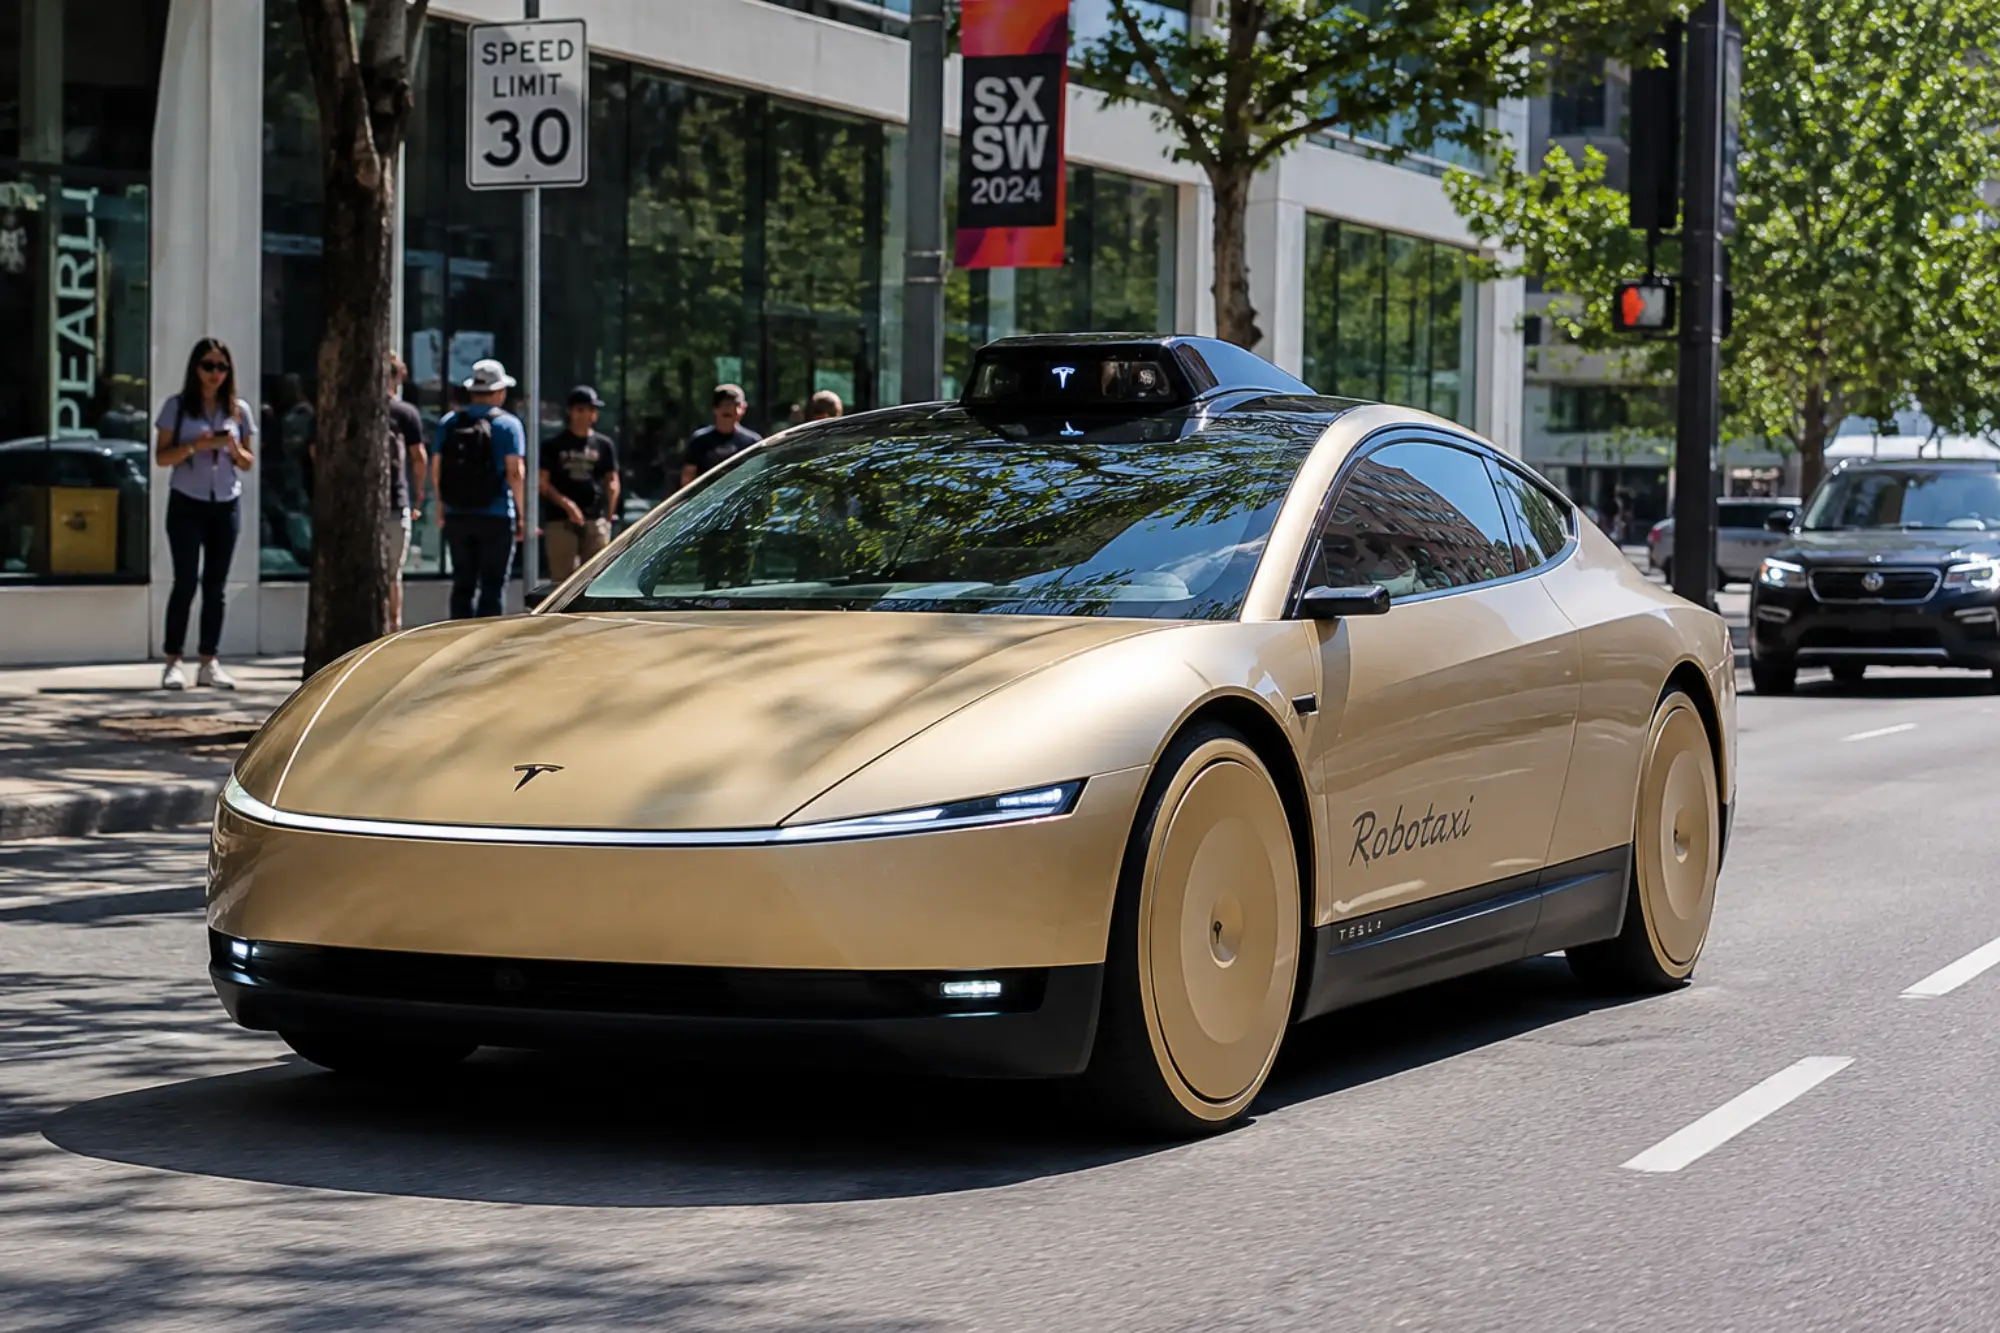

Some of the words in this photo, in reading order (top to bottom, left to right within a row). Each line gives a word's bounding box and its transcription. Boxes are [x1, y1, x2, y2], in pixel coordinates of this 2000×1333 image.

[482, 39, 574, 65] SPEED
[493, 73, 562, 98] LIMIT
[973, 76, 1046, 124] SX
[482, 108, 572, 167] 30
[971, 124, 1049, 172] SW
[971, 176, 1042, 204] 2024
[1348, 795, 1474, 869] Robotaxi
